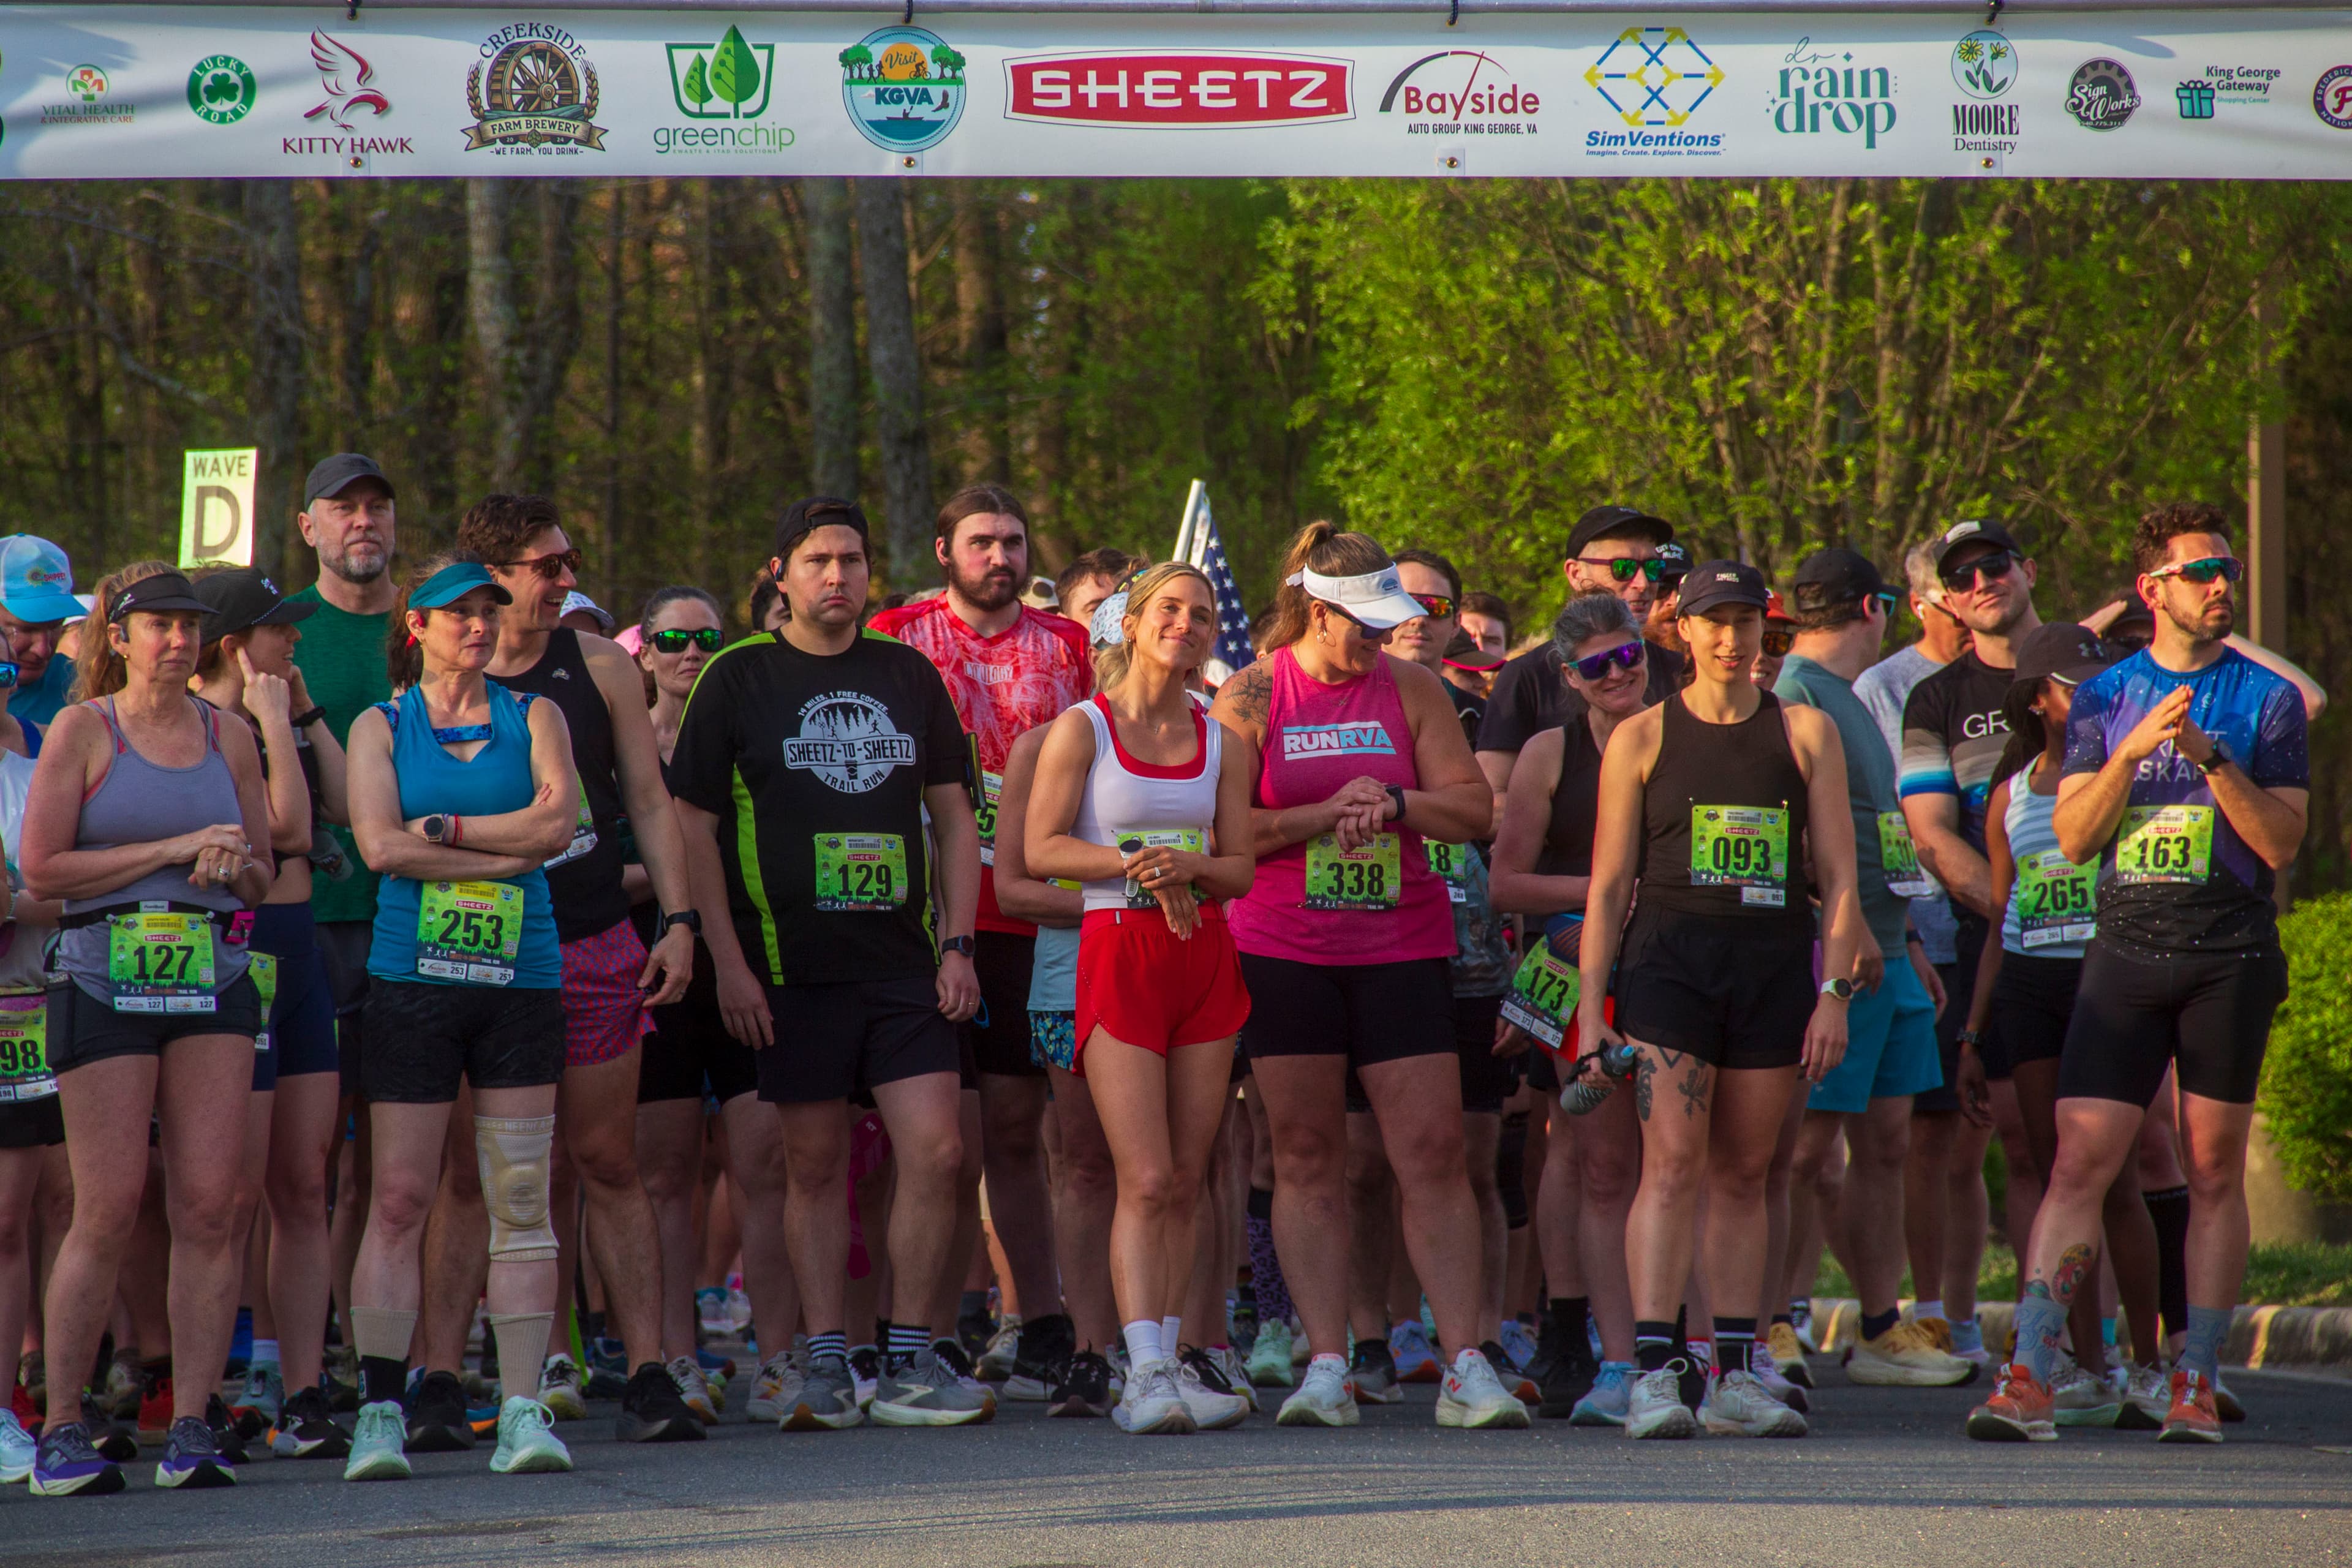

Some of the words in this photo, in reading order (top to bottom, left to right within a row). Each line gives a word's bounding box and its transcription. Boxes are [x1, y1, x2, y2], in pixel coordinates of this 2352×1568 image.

[480, 22, 586, 60] CREEKSIDE
[192, 56, 250, 77] LUCKY
[885, 51, 918, 69] Visit
[2206, 66, 2234, 80] King
[2237, 66, 2280, 80] George
[1779, 51, 1890, 98] rain
[2217, 80, 2270, 94] Gateway
[2316, 69, 2352, 100] FREDERIC
[875, 87, 933, 105] KGVA
[1032, 70, 1328, 108] SHEETZ
[1404, 83, 1540, 121] Bayside
[2067, 84, 2108, 112] Sign
[42, 105, 78, 115] VITAL
[83, 104, 135, 115] HEALTH
[195, 103, 248, 122] ROAD
[1774, 88, 1896, 149] drop
[1952, 104, 2019, 135] MOORE
[2081, 93, 2140, 121] Works
[491, 120, 521, 135] FARM
[525, 119, 580, 134] BREWERY
[654, 122, 795, 154] greenchip
[1408, 123, 1429, 134] AUTO
[1433, 123, 1461, 134] GROUP
[1464, 123, 1484, 134] KING
[1488, 123, 1523, 135] GEORGE,
[1526, 123, 1537, 134] VA
[282, 137, 345, 154] KITTY
[350, 137, 414, 154] HAWK
[1954, 138, 2017, 154] Dentistry
[193, 456, 247, 477] WAVE
[193, 486, 241, 559] D
[798, 707, 806, 716] 14
[860, 695, 889, 715] COFFEE.
[1283, 728, 1393, 753] RUNRVA
[824, 772, 858, 792] TRAIL
[862, 769, 885, 790] RUN
[1713, 837, 1771, 872] 093
[2136, 837, 2191, 868] 163
[838, 864, 892, 897] 129
[1327, 862, 1384, 896] 338
[457, 901, 493, 910] SHEETZ
[2033, 876, 2089, 914] 265
[439, 909, 503, 950] 253
[133, 944, 194, 980] 127
[450, 966, 464, 975] 253
[499, 973, 511, 981] 253
[1525, 966, 1569, 1012] 173
